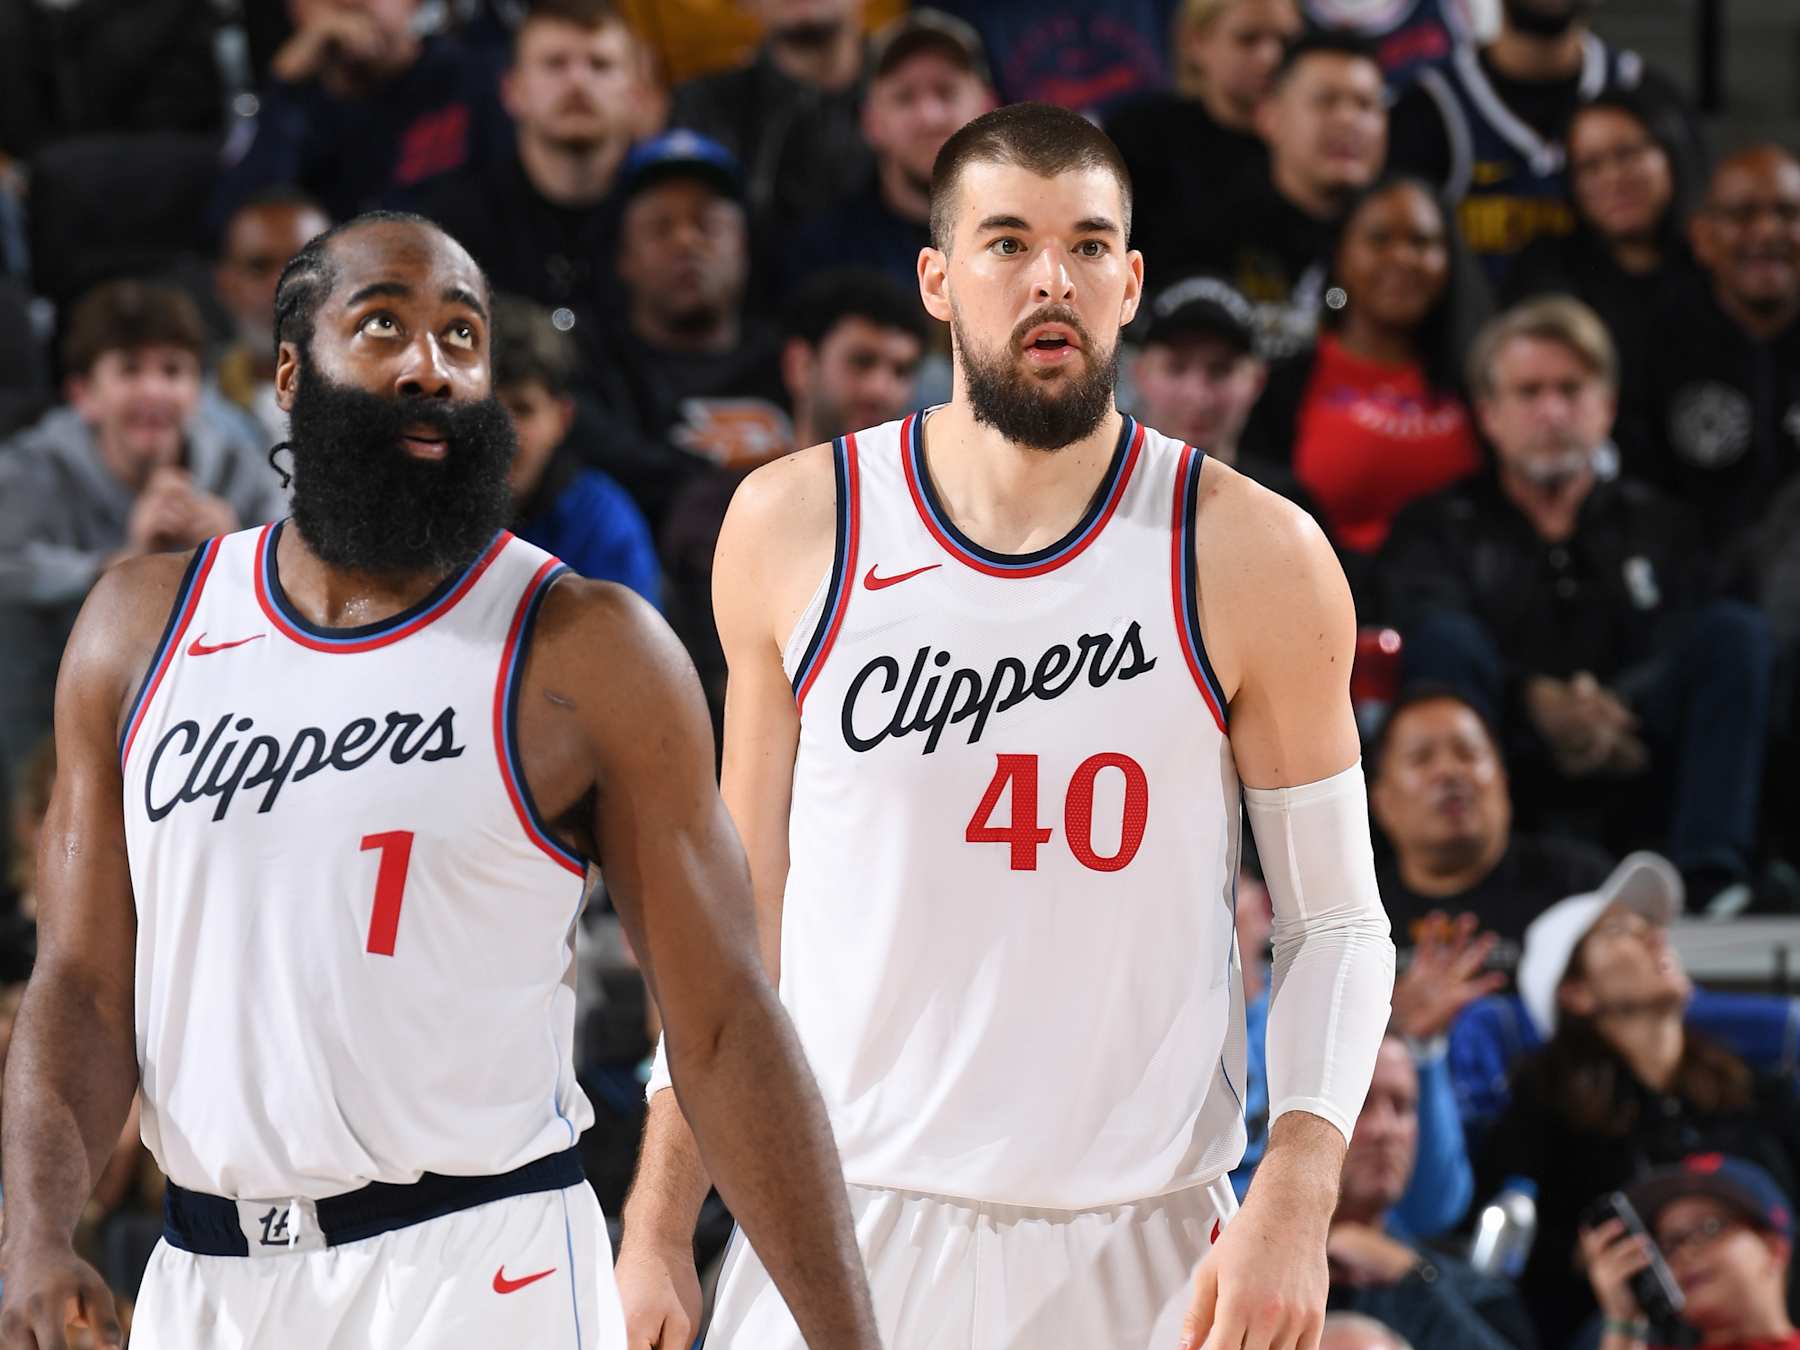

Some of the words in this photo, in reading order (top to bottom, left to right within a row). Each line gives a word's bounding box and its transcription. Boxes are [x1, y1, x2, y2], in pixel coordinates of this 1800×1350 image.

[841, 620, 1157, 755] Clippers
[145, 706, 466, 822] Clippers
[965, 752, 1148, 872] 40
[360, 830, 414, 956] 1
